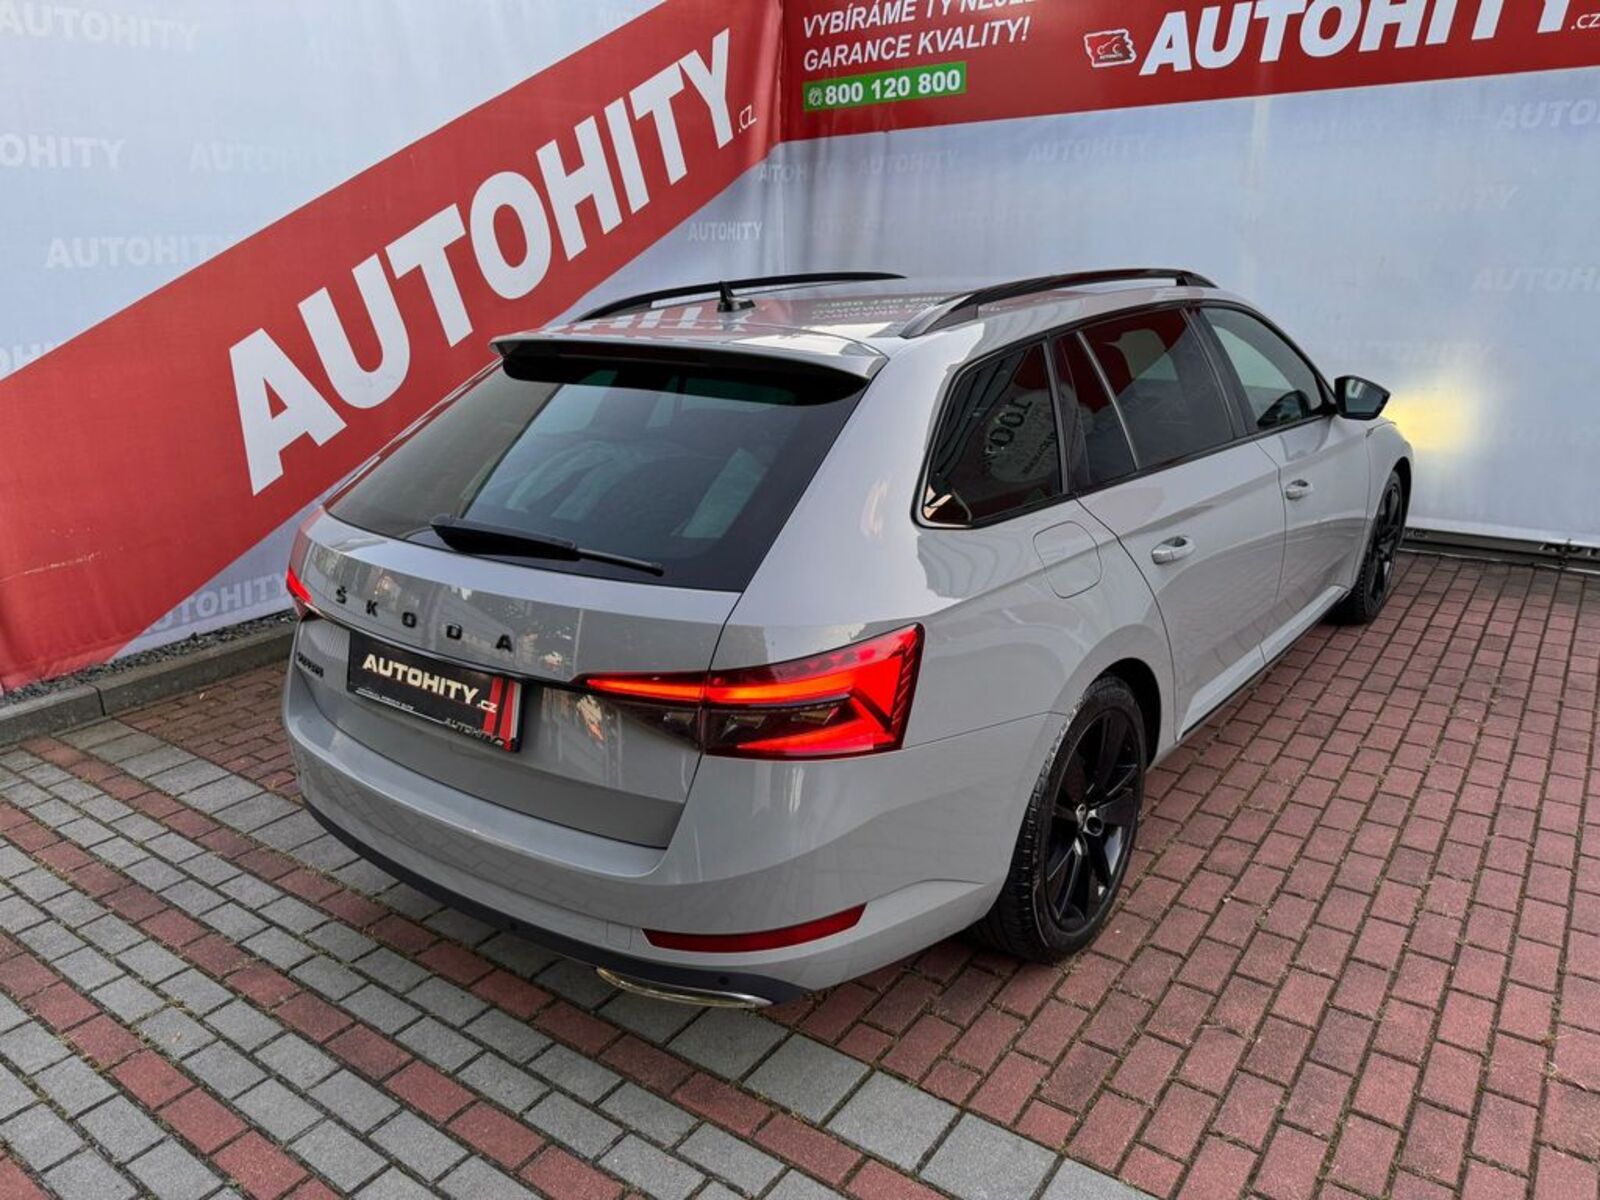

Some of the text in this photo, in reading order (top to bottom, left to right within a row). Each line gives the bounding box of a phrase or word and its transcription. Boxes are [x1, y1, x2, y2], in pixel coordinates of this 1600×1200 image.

[804, 16, 1031, 71] GARANCE KVALITY!
[825, 69, 961, 105] 800 120 800
[687, 221, 764, 242] AUTOHITY
